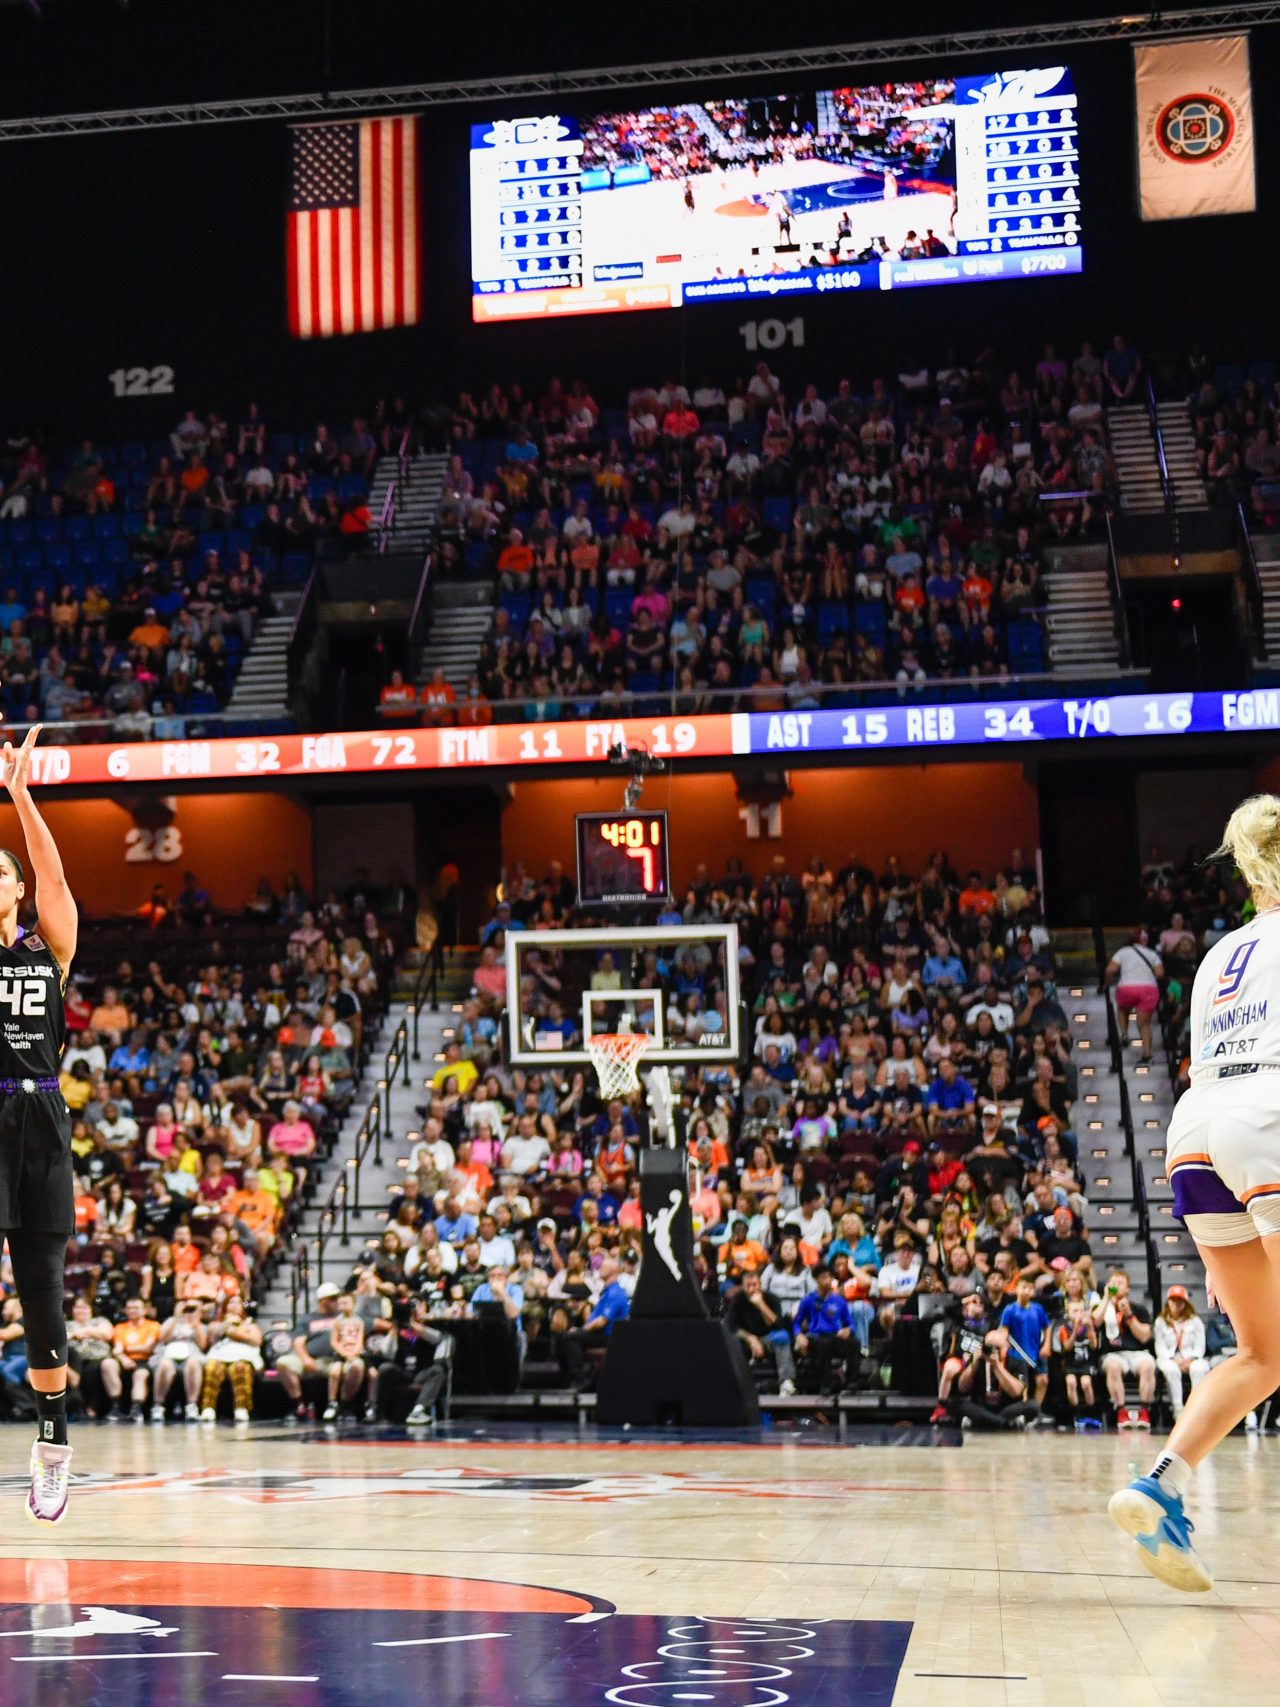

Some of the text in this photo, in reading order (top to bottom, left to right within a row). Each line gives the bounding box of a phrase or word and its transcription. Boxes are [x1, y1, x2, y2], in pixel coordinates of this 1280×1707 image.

[739, 317, 804, 351] 101
[108, 365, 174, 397] 122
[907, 707, 1034, 741] REB 34
[1064, 700, 1192, 737] T/O 16
[1222, 693, 1280, 727] FGM
[441, 730, 561, 762] FTM 11
[652, 724, 696, 752] 19
[767, 715, 888, 749] AST 15
[30, 748, 130, 784] T/O 6
[162, 743, 280, 775] FGM 32
[372, 737, 416, 765] 72
[601, 820, 659, 848] 4:01
[738, 803, 783, 839] 11
[125, 827, 183, 863] 28
[626, 847, 653, 892] 7
[1212, 938, 1261, 1006] 9
[4, 1023, 19, 1032] Yale
[699, 1033, 726, 1046] AT&T
[8, 1041, 31, 1049] ealth
[1214, 1038, 1259, 1057] AT&T
